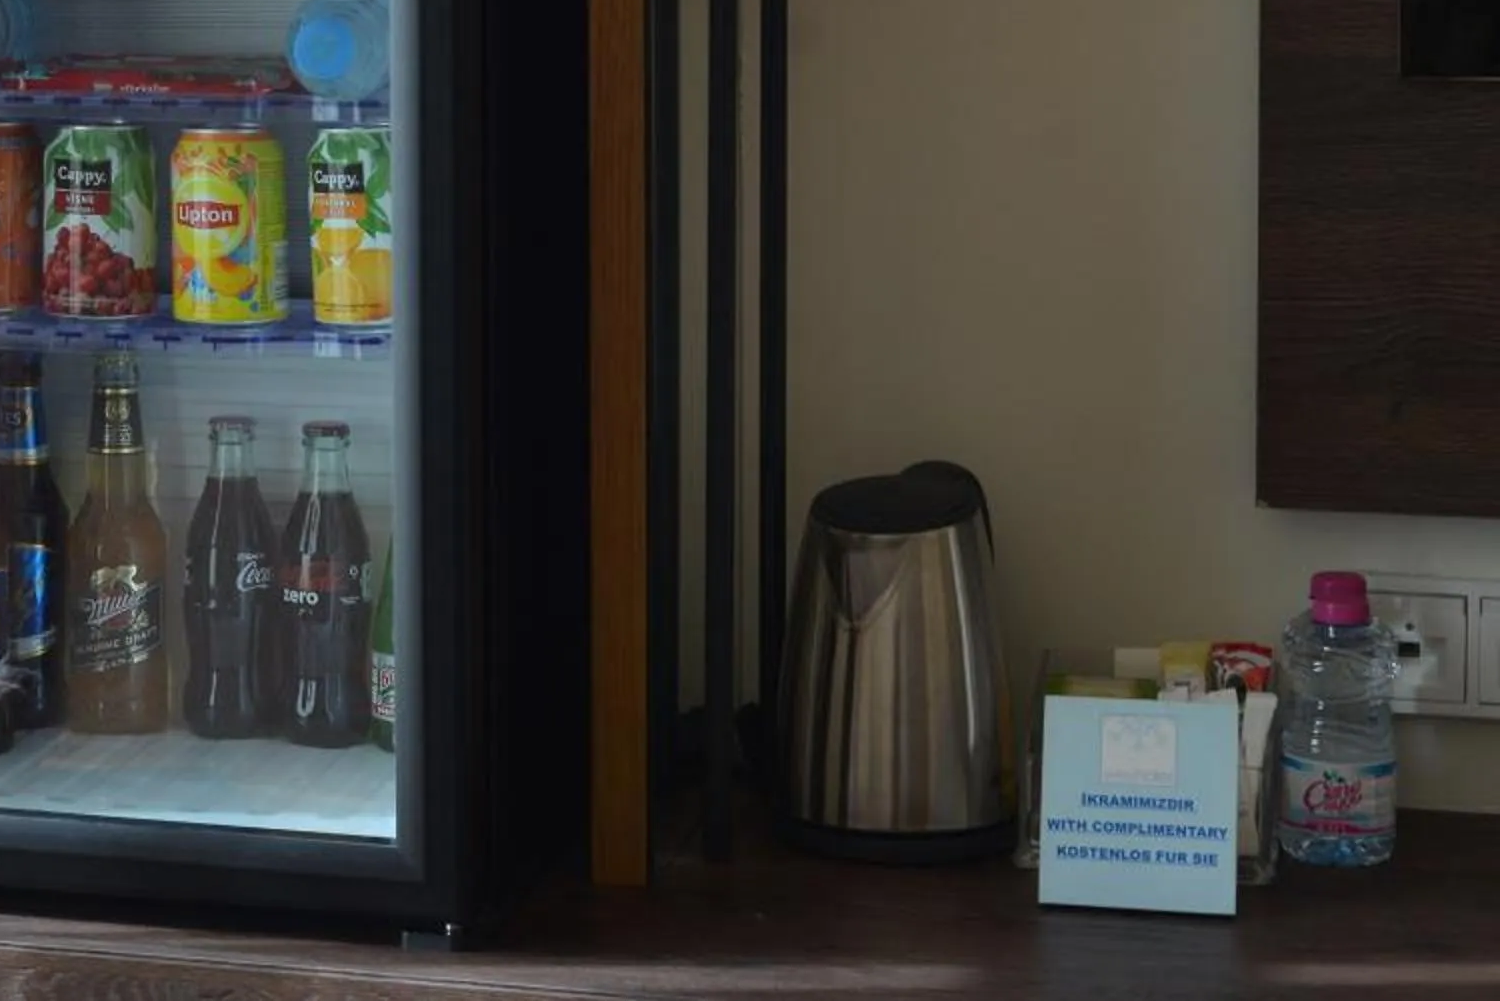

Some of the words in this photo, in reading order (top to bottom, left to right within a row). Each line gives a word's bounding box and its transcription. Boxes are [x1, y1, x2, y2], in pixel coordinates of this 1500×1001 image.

[57, 165, 106, 187] Cappy
[314, 169, 357, 190] Cappy
[178, 205, 234, 226] Lipton
[283, 587, 320, 607] zero
[1047, 818, 1087, 833] WITH
[1091, 820, 1228, 841] COMPLIMENTARY
[1056, 845, 1151, 863] KOSTENLOS
[1192, 854, 1219, 868] SIE
